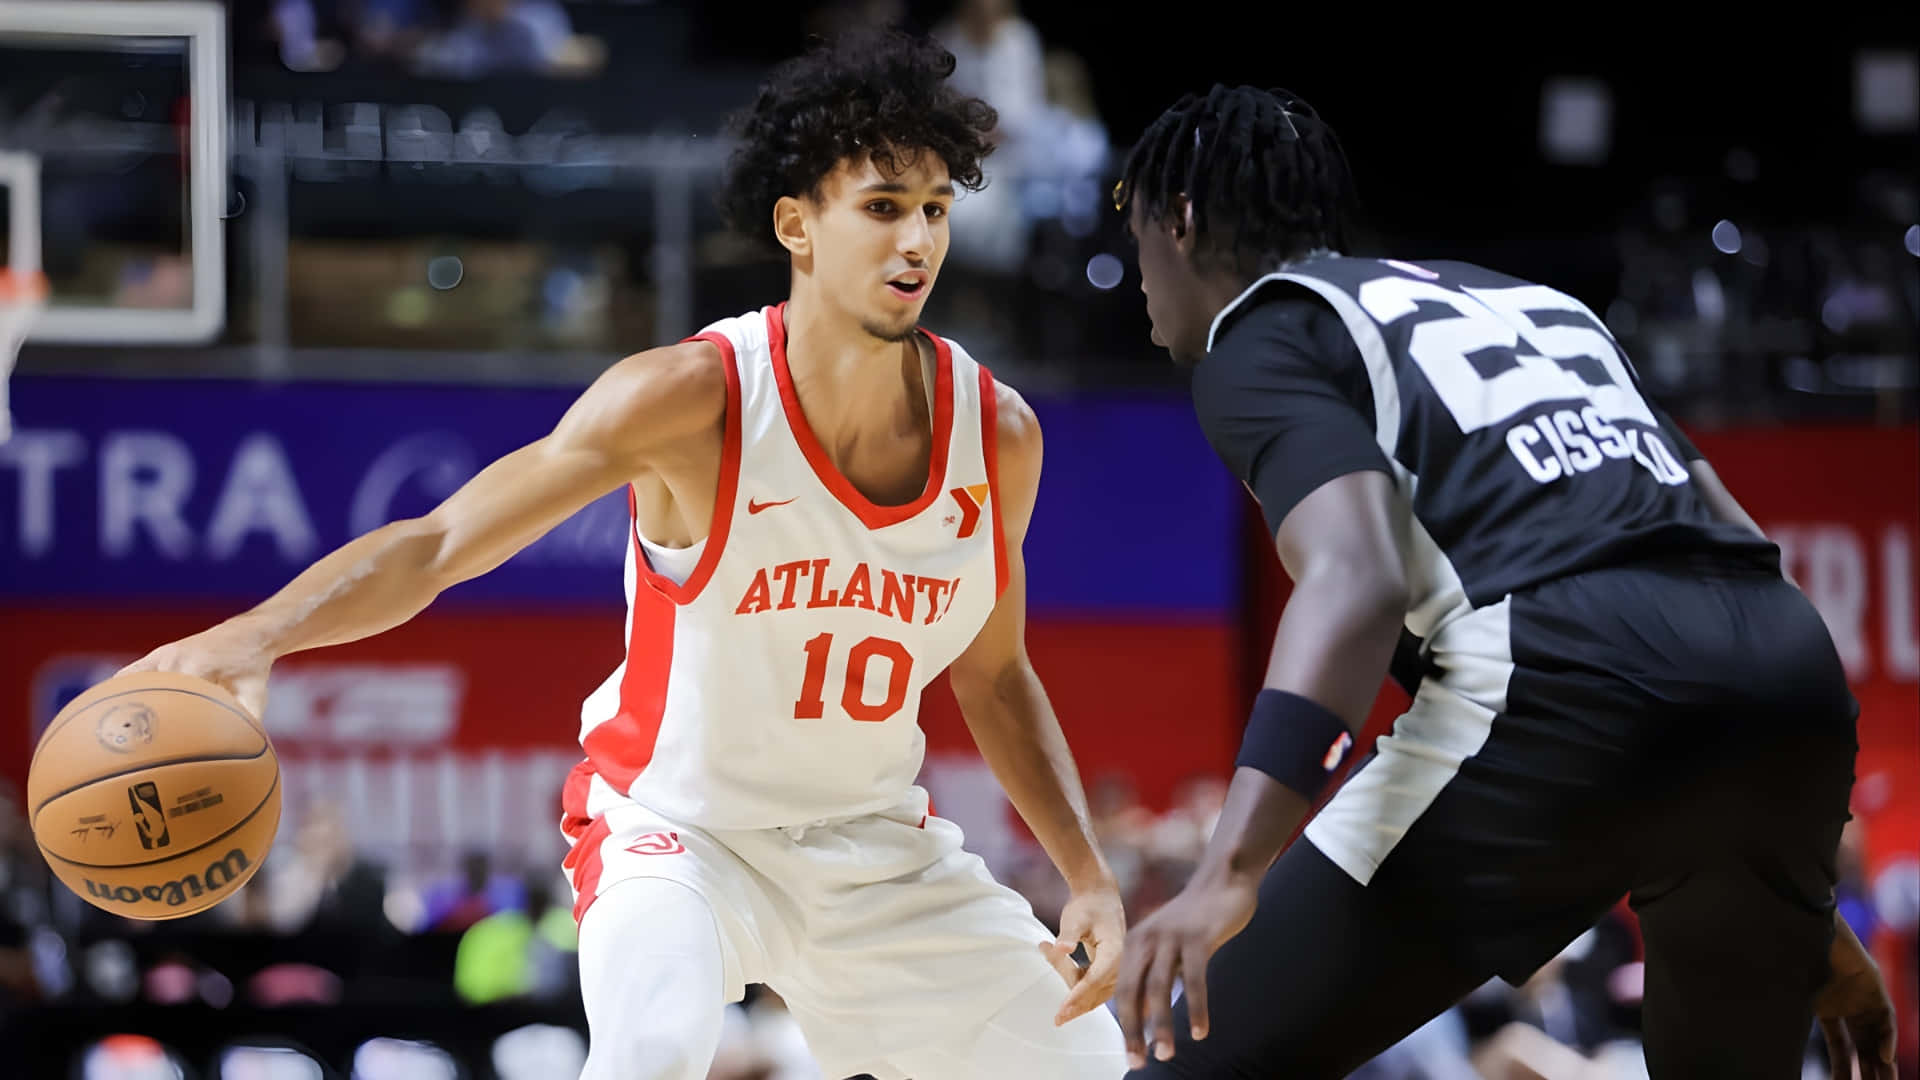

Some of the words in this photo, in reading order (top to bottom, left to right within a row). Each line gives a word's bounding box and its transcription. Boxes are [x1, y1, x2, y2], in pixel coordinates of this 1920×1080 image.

[1359, 276, 1660, 435] 25
[794, 631, 914, 722] 10
[84, 847, 252, 906] Wilson
